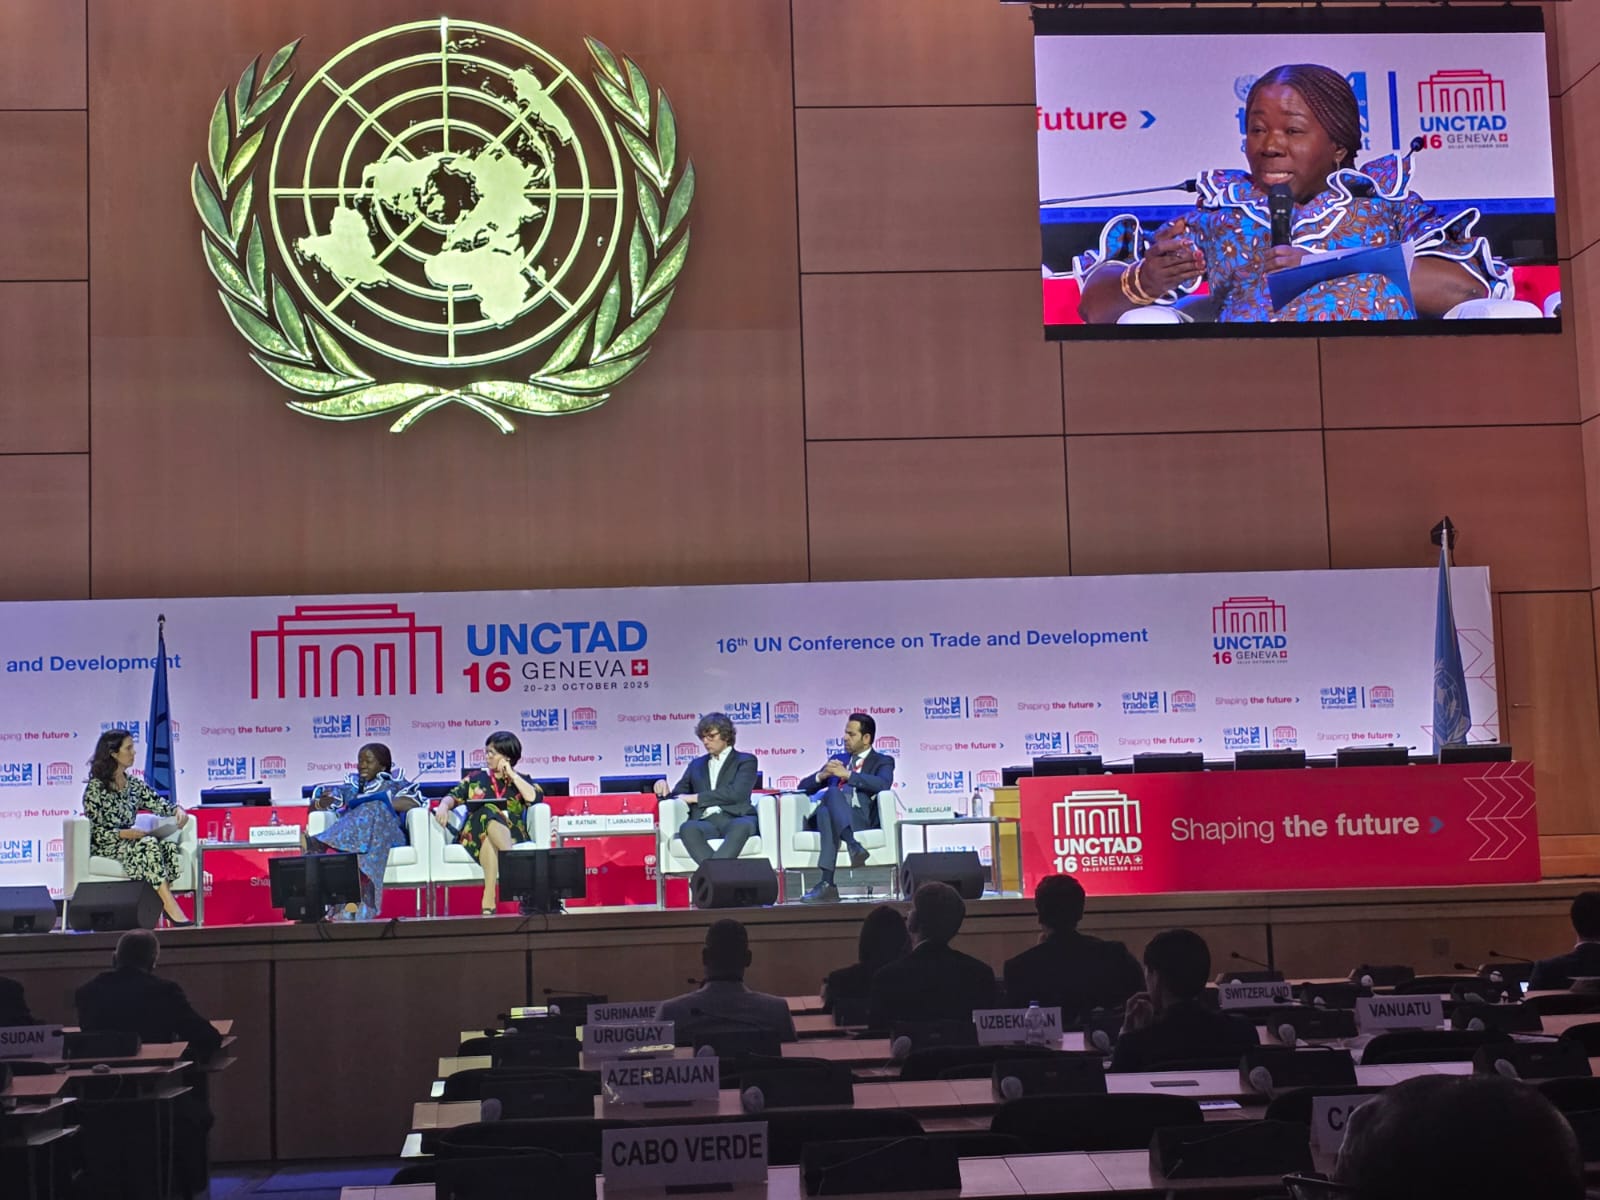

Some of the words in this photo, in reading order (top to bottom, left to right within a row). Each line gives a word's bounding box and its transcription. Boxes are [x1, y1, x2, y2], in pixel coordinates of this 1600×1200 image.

[1037, 107, 1127, 131] future
[1420, 115, 1507, 132] UNCTAD
[1447, 134, 1497, 144] GENEVA
[467, 620, 648, 656] UNCTAD
[716, 637, 748, 653] 16th
[754, 637, 782, 652] UN
[788, 635, 896, 651] Conference
[901, 636, 923, 649] on
[929, 632, 981, 647] Trade
[986, 631, 1021, 647] and
[1027, 628, 1149, 647] Development
[1213, 635, 1287, 650] UNCTAD
[1212, 651, 1233, 665] 16
[1236, 651, 1279, 660] GENEVA
[7, 657, 43, 673] and
[463, 662, 511, 693] 16
[522, 660, 626, 680] GENEVA
[562, 682, 618, 691] OCTOBER
[623, 681, 650, 689] 2025
[1330, 687, 1346, 696] UN
[934, 697, 949, 705] UN
[1132, 692, 1147, 701] UN
[1250, 696, 1264, 704] the
[1266, 696, 1292, 704] future
[1320, 696, 1346, 705] trade
[734, 702, 750, 711] UN
[1052, 701, 1066, 709] the
[1068, 701, 1094, 709] future
[1122, 700, 1148, 709] trade
[531, 709, 547, 718] UN
[870, 706, 896, 714] future
[925, 705, 950, 714] trade
[323, 715, 340, 724] UN
[652, 713, 667, 721] the
[669, 712, 696, 720] future
[447, 719, 463, 727] the
[465, 718, 491, 727] future
[521, 717, 547, 727] trade
[238, 725, 253, 733] the
[255, 725, 283, 733] future
[313, 724, 340, 733] trade
[1233, 728, 1249, 736] UN
[24, 731, 39, 739] the
[41, 731, 70, 740] future
[1034, 733, 1050, 741] UN
[1367, 731, 1393, 739] future
[1153, 736, 1167, 744] the
[1168, 736, 1195, 744] future
[1224, 736, 1249, 744] trade
[634, 744, 650, 753] UN
[955, 742, 969, 750] the
[971, 741, 997, 750] future
[1025, 741, 1051, 750] trade
[428, 751, 444, 760] UN
[771, 747, 797, 755] future
[218, 757, 234, 767] UN
[568, 754, 595, 762] future
[624, 753, 650, 762] trade
[4, 764, 20, 773] UN
[208, 766, 235, 775] trade
[936, 771, 952, 780] UN
[928, 780, 953, 789] trade
[24, 808, 39, 817] the
[41, 808, 70, 817] future
[1171, 817, 1274, 844] Shaping
[1282, 814, 1328, 838] the
[1335, 812, 1420, 837] future
[4, 840, 20, 850] UN
[1054, 836, 1142, 856] UNCTAD
[1053, 856, 1078, 873] 16
[1081, 856, 1132, 866] GENEVA
[1224, 986, 1289, 1000] SWITZERLAND
[594, 1006, 657, 1021] SURINAME
[1369, 1001, 1432, 1017] VANUATU
[1, 1031, 44, 1044] SUDAN
[593, 1027, 664, 1044] URUGUAY
[607, 1065, 715, 1086] AZERBAIJAN
[611, 1138, 679, 1167] CABO
[685, 1133, 763, 1162] VERDE
